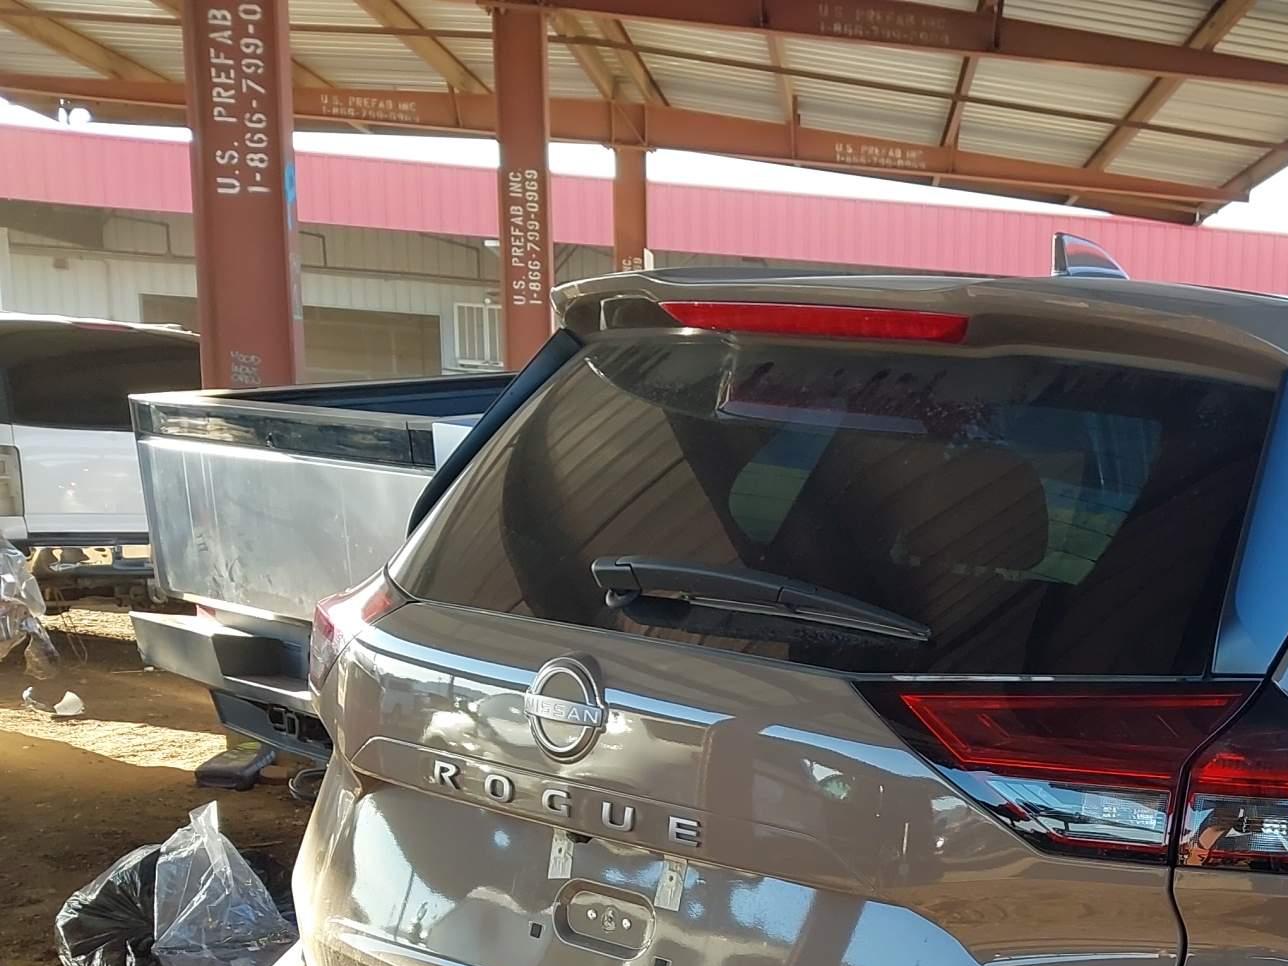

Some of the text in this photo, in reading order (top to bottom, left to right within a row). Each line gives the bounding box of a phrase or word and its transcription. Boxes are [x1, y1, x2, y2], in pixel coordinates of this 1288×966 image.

[207, 8, 241, 194] U.S. PREFAB
[348, 95, 393, 110] PREFAB
[509, 205, 526, 267] PREFAB
[524, 169, 543, 304] 1-866-799-0969
[525, 694, 599, 724] NISSAN
[433, 759, 700, 847] ROGUE
